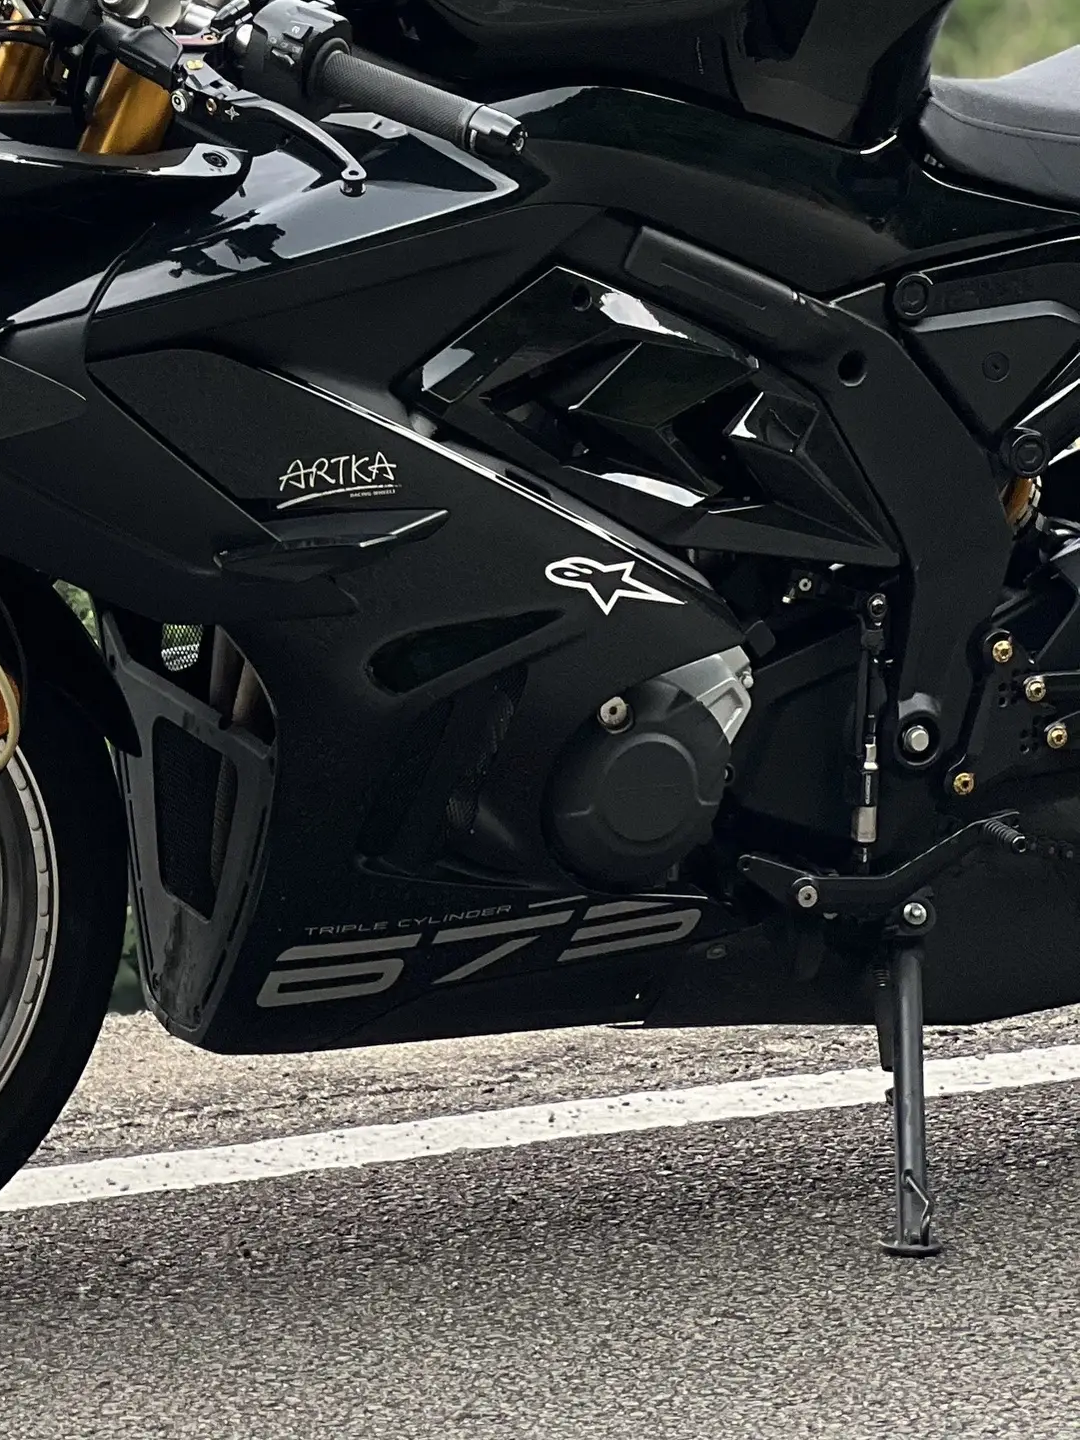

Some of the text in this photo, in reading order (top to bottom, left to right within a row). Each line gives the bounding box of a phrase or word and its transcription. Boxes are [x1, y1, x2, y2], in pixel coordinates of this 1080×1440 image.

[279, 451, 397, 492] ARTKA
[305, 904, 512, 935] TRIPLE CYLINDER
[256, 899, 702, 1008] 675
